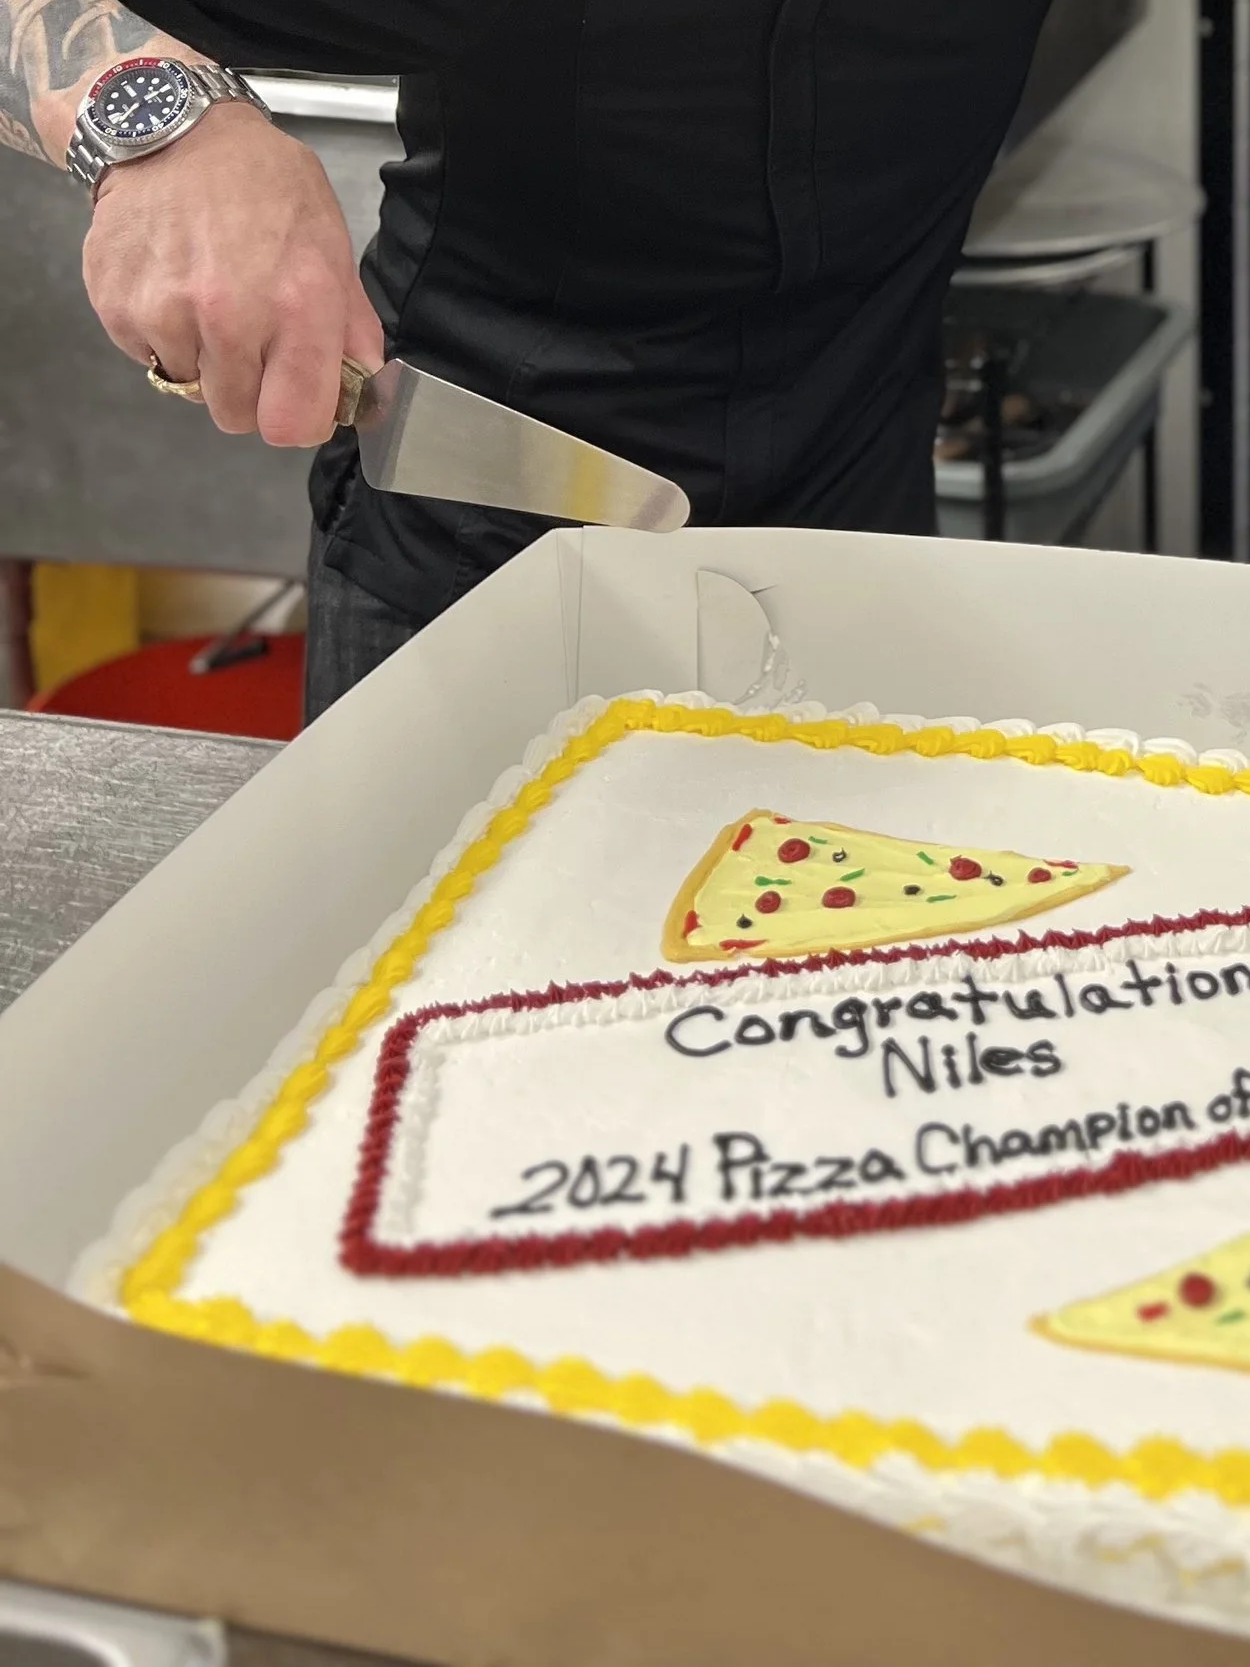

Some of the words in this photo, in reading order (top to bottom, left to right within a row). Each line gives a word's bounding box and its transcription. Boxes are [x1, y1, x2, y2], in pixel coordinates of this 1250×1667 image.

[882, 1031, 1064, 1098] Niles
[489, 1141, 690, 1219] 2024
[713, 1131, 906, 1201] Pizza
[914, 1100, 1195, 1176] Champion
